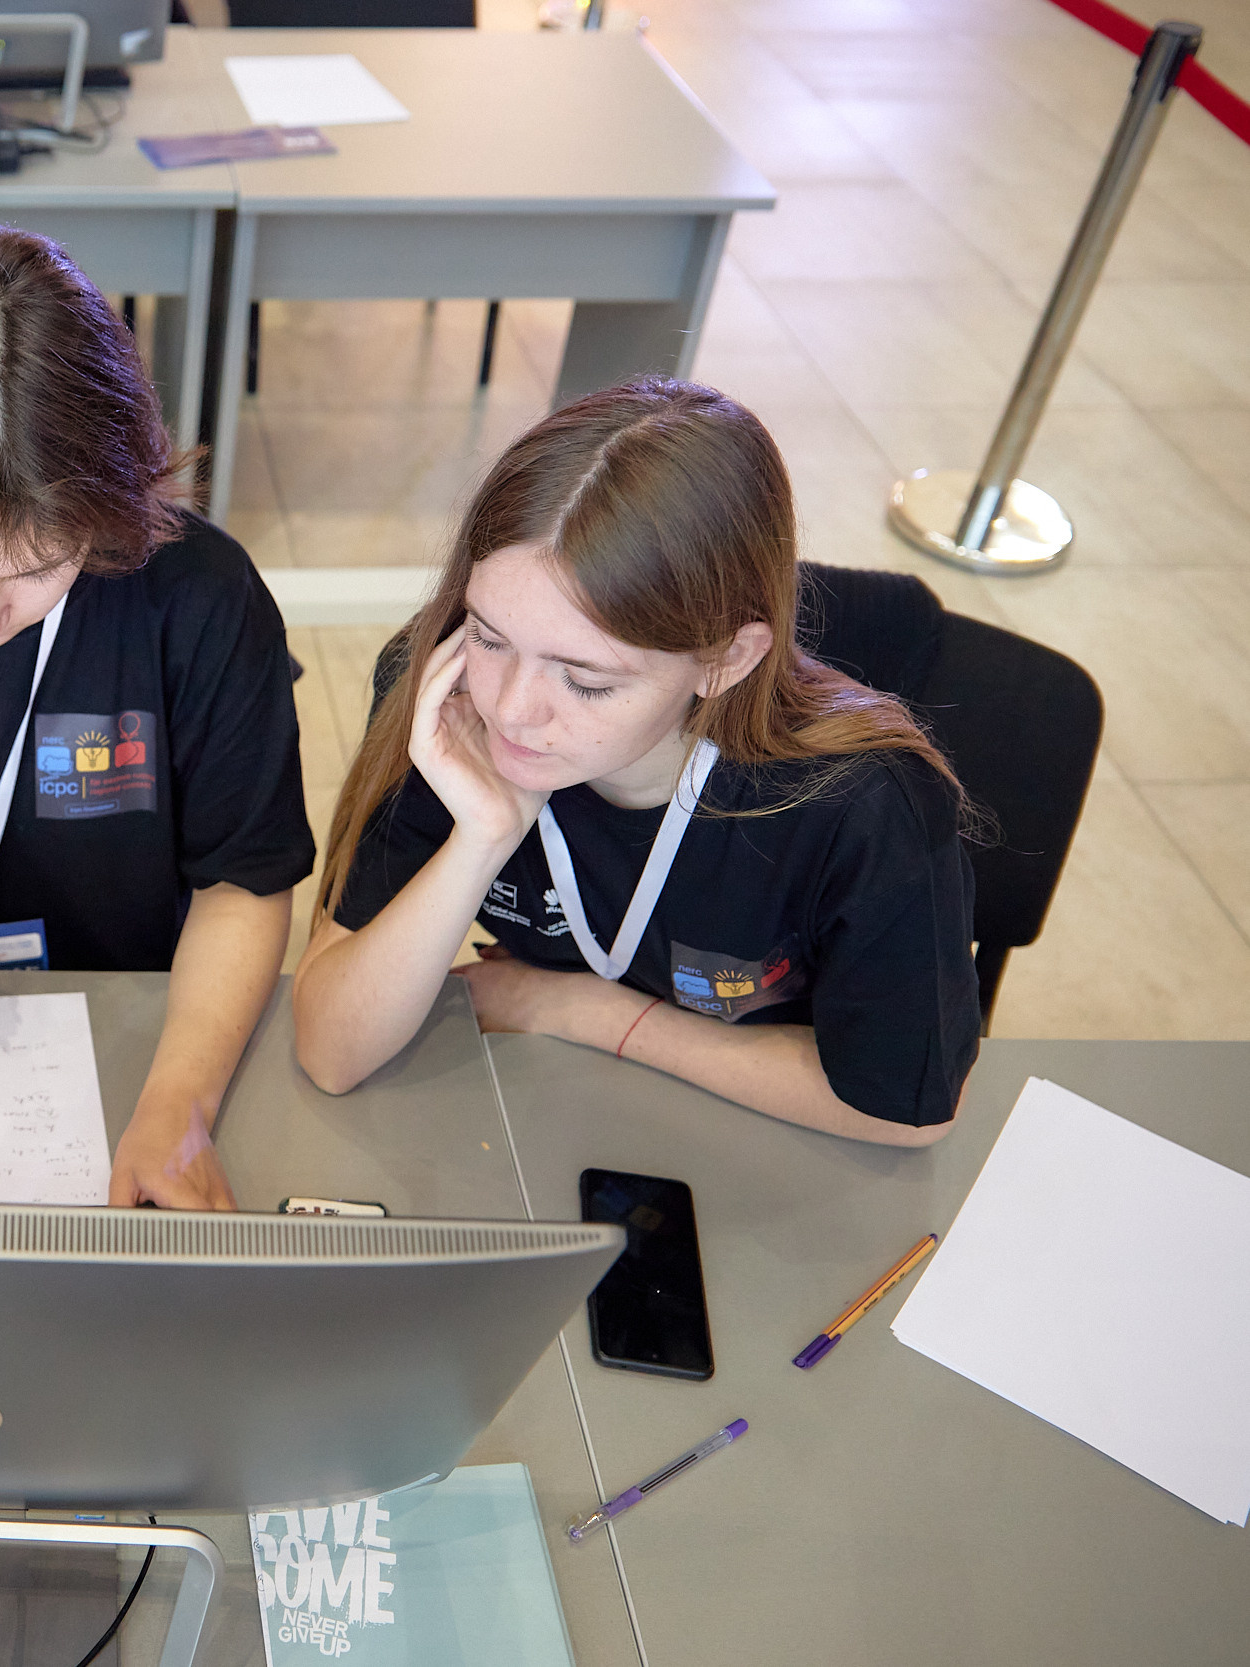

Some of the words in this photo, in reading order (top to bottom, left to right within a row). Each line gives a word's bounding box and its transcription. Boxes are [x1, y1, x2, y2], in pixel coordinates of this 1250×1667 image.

[39, 779, 79, 799] icpc
[678, 964, 702, 976] nerc
[282, 1608, 349, 1639] NEVER
[278, 1626, 322, 1644] GIVE
[319, 1634, 352, 1659] UP
